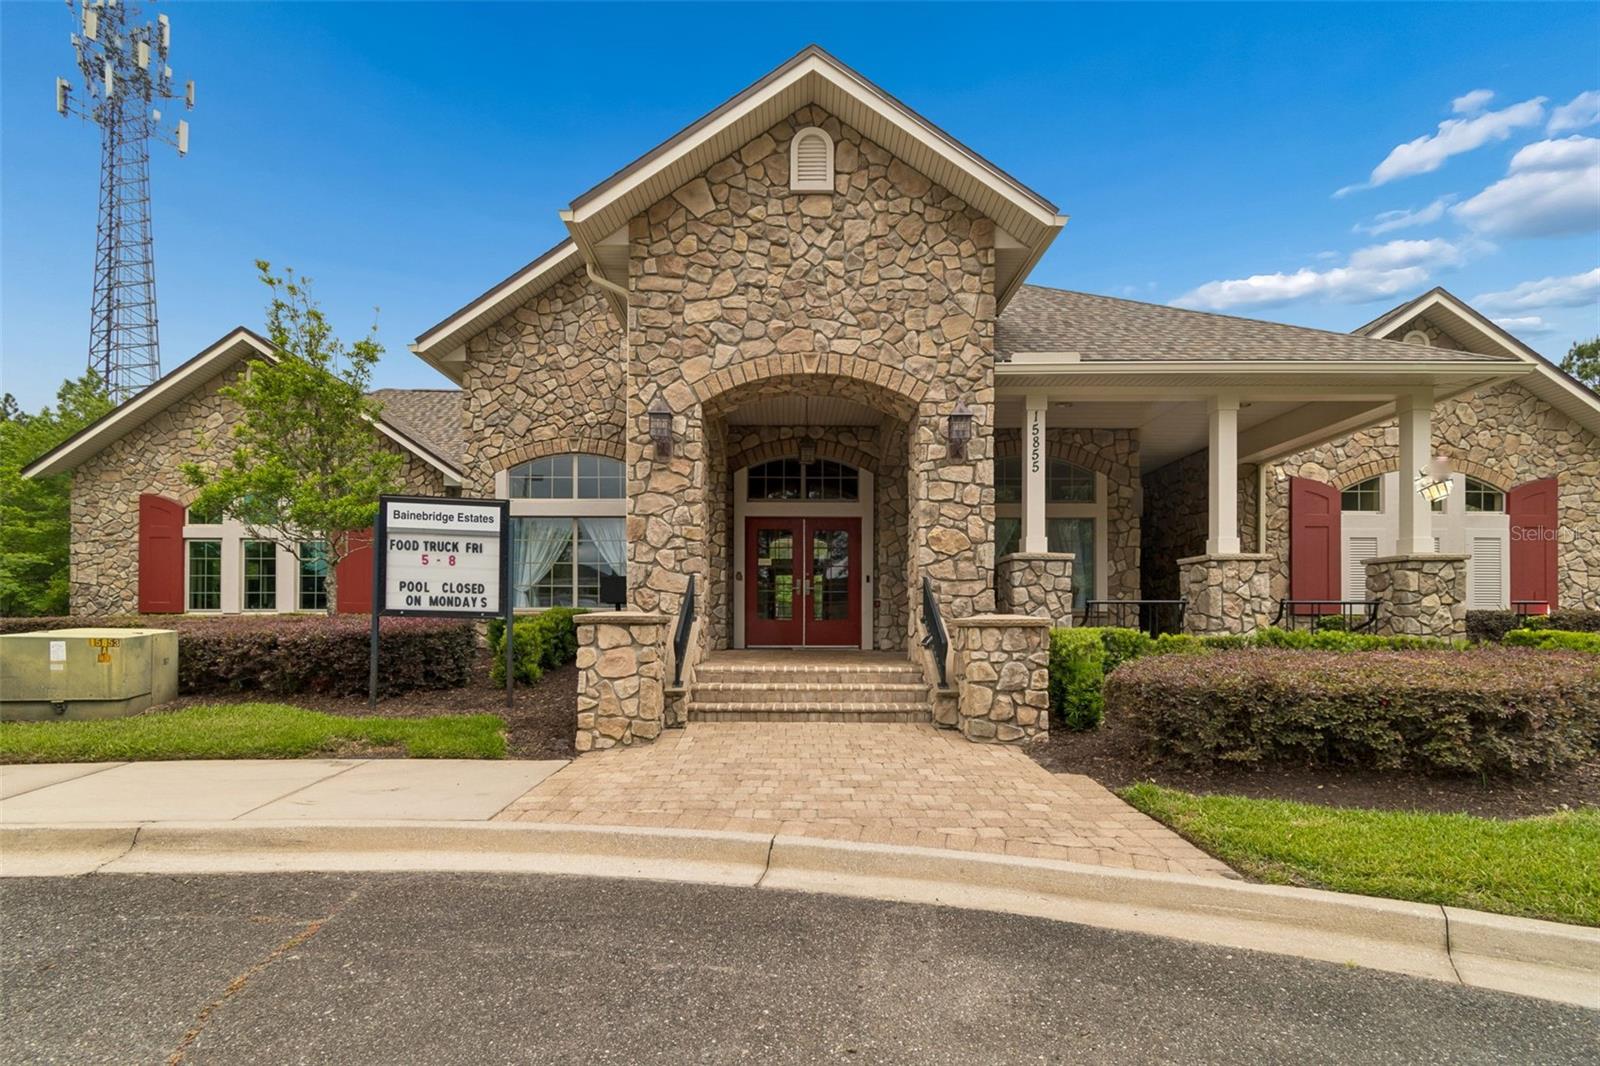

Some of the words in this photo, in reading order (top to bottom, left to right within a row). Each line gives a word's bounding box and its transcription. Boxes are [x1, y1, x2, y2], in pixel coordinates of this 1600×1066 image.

[1032, 411, 1040, 473] 15855
[393, 510, 455, 524] Bainebridge
[457, 512, 495, 524] Estates
[389, 539, 420, 551] FOOD
[423, 541, 459, 553] TRUCK
[465, 542, 483, 554] FRI
[421, 554, 429, 566] 5
[448, 555, 456, 567] 8
[399, 581, 430, 593] POOL
[441, 582, 485, 595] CLOSED
[405, 595, 421, 606] ON
